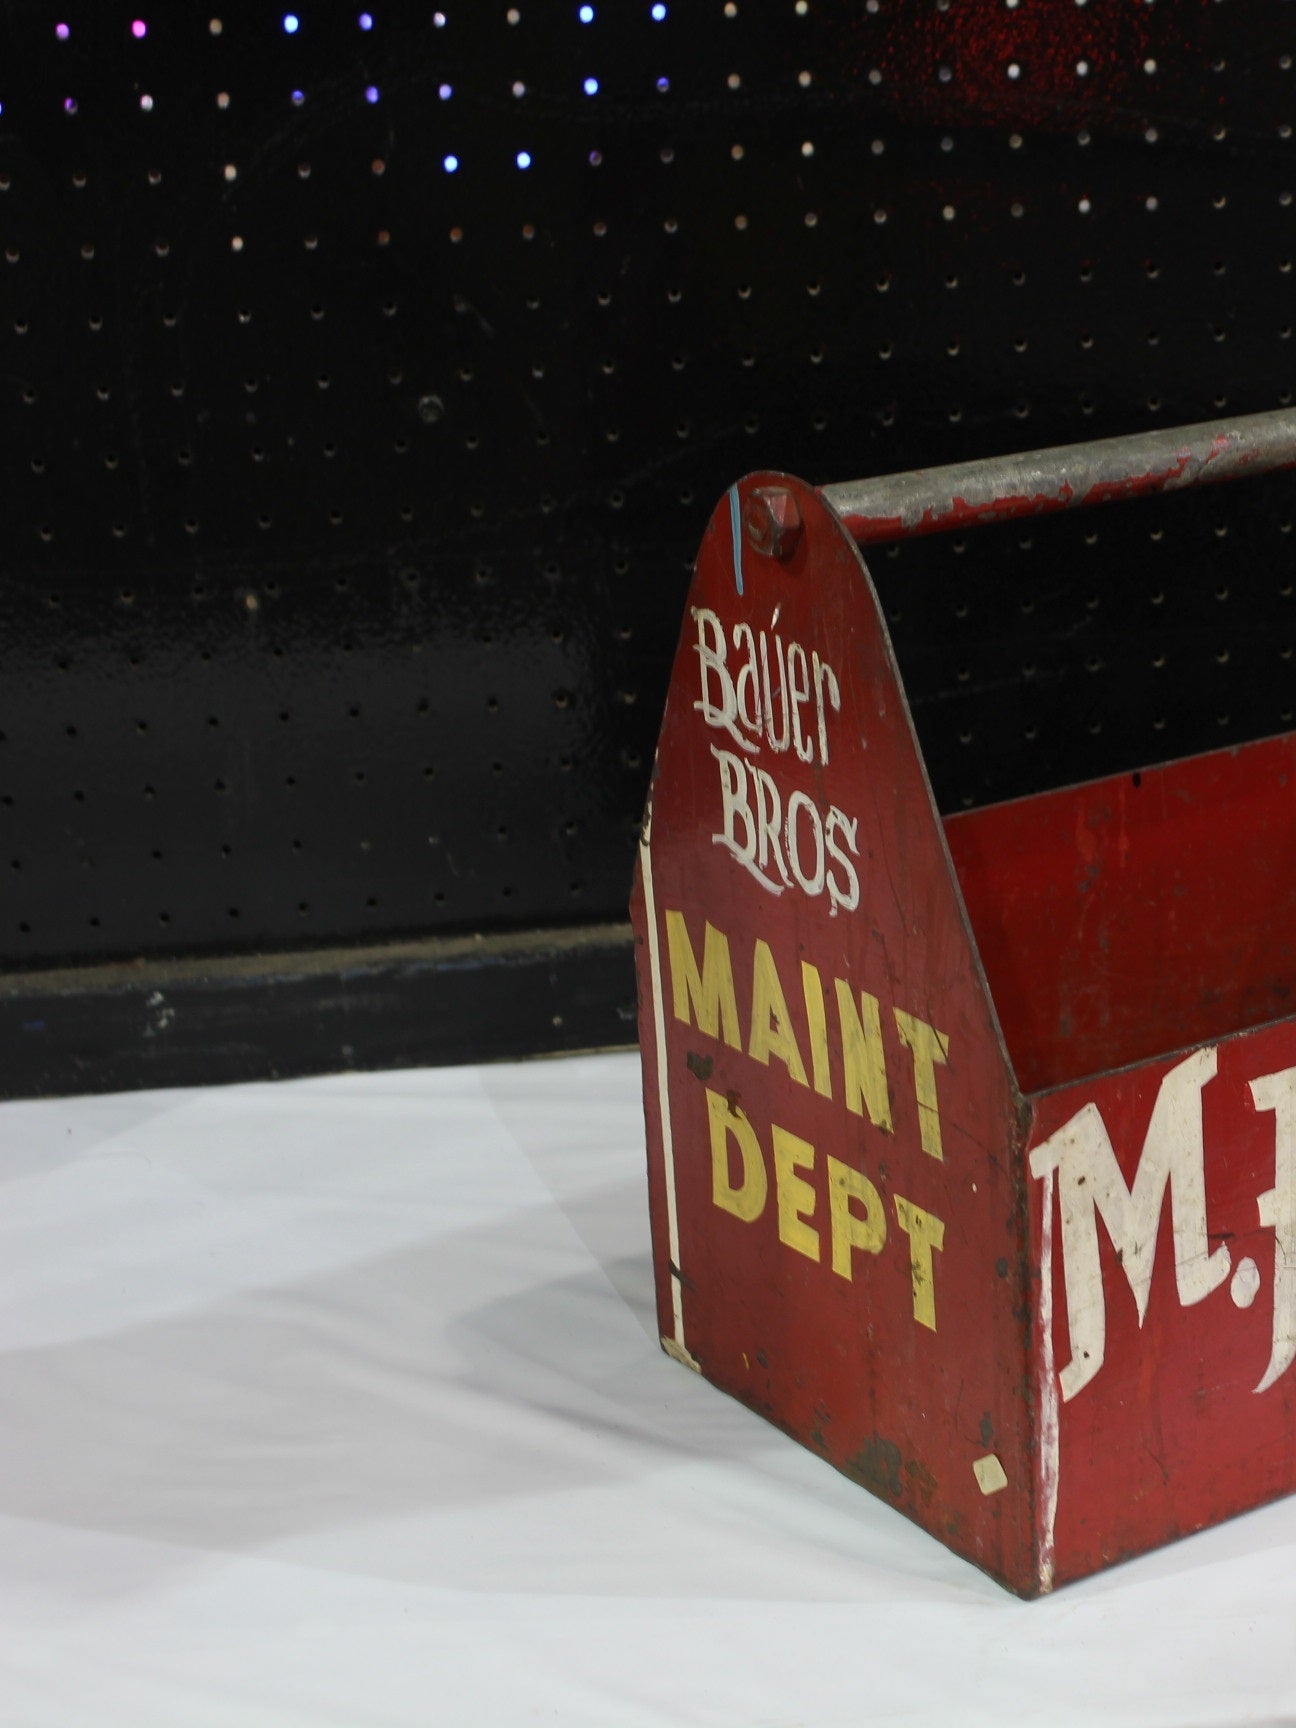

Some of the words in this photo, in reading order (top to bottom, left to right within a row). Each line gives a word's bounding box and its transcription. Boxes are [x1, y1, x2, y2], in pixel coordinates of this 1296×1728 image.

[710, 743, 860, 916] BROS
[665, 909, 949, 1162] MAINT
[705, 1087, 946, 1333] DEPT
